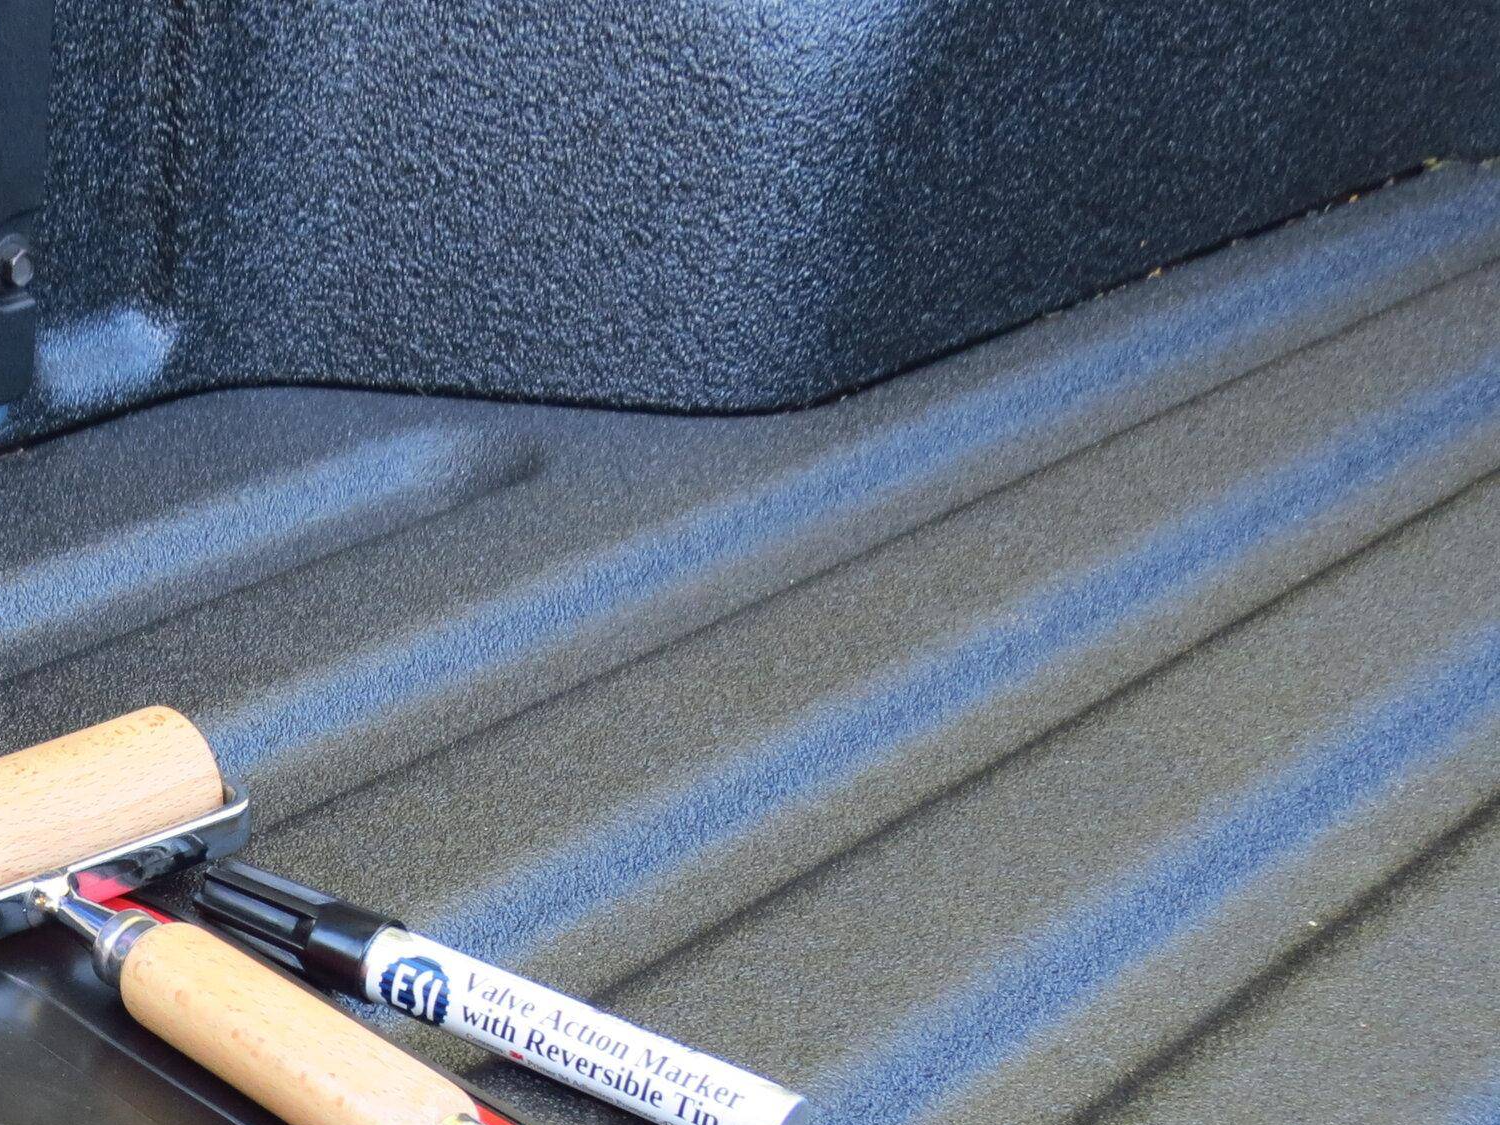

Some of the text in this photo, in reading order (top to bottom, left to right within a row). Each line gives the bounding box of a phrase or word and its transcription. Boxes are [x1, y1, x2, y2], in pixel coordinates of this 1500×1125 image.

[391, 962, 444, 1022] ESI
[466, 972, 746, 1110] Valve Action Marker
[462, 1004, 516, 1044] with
[524, 1028, 664, 1109] Reversible
